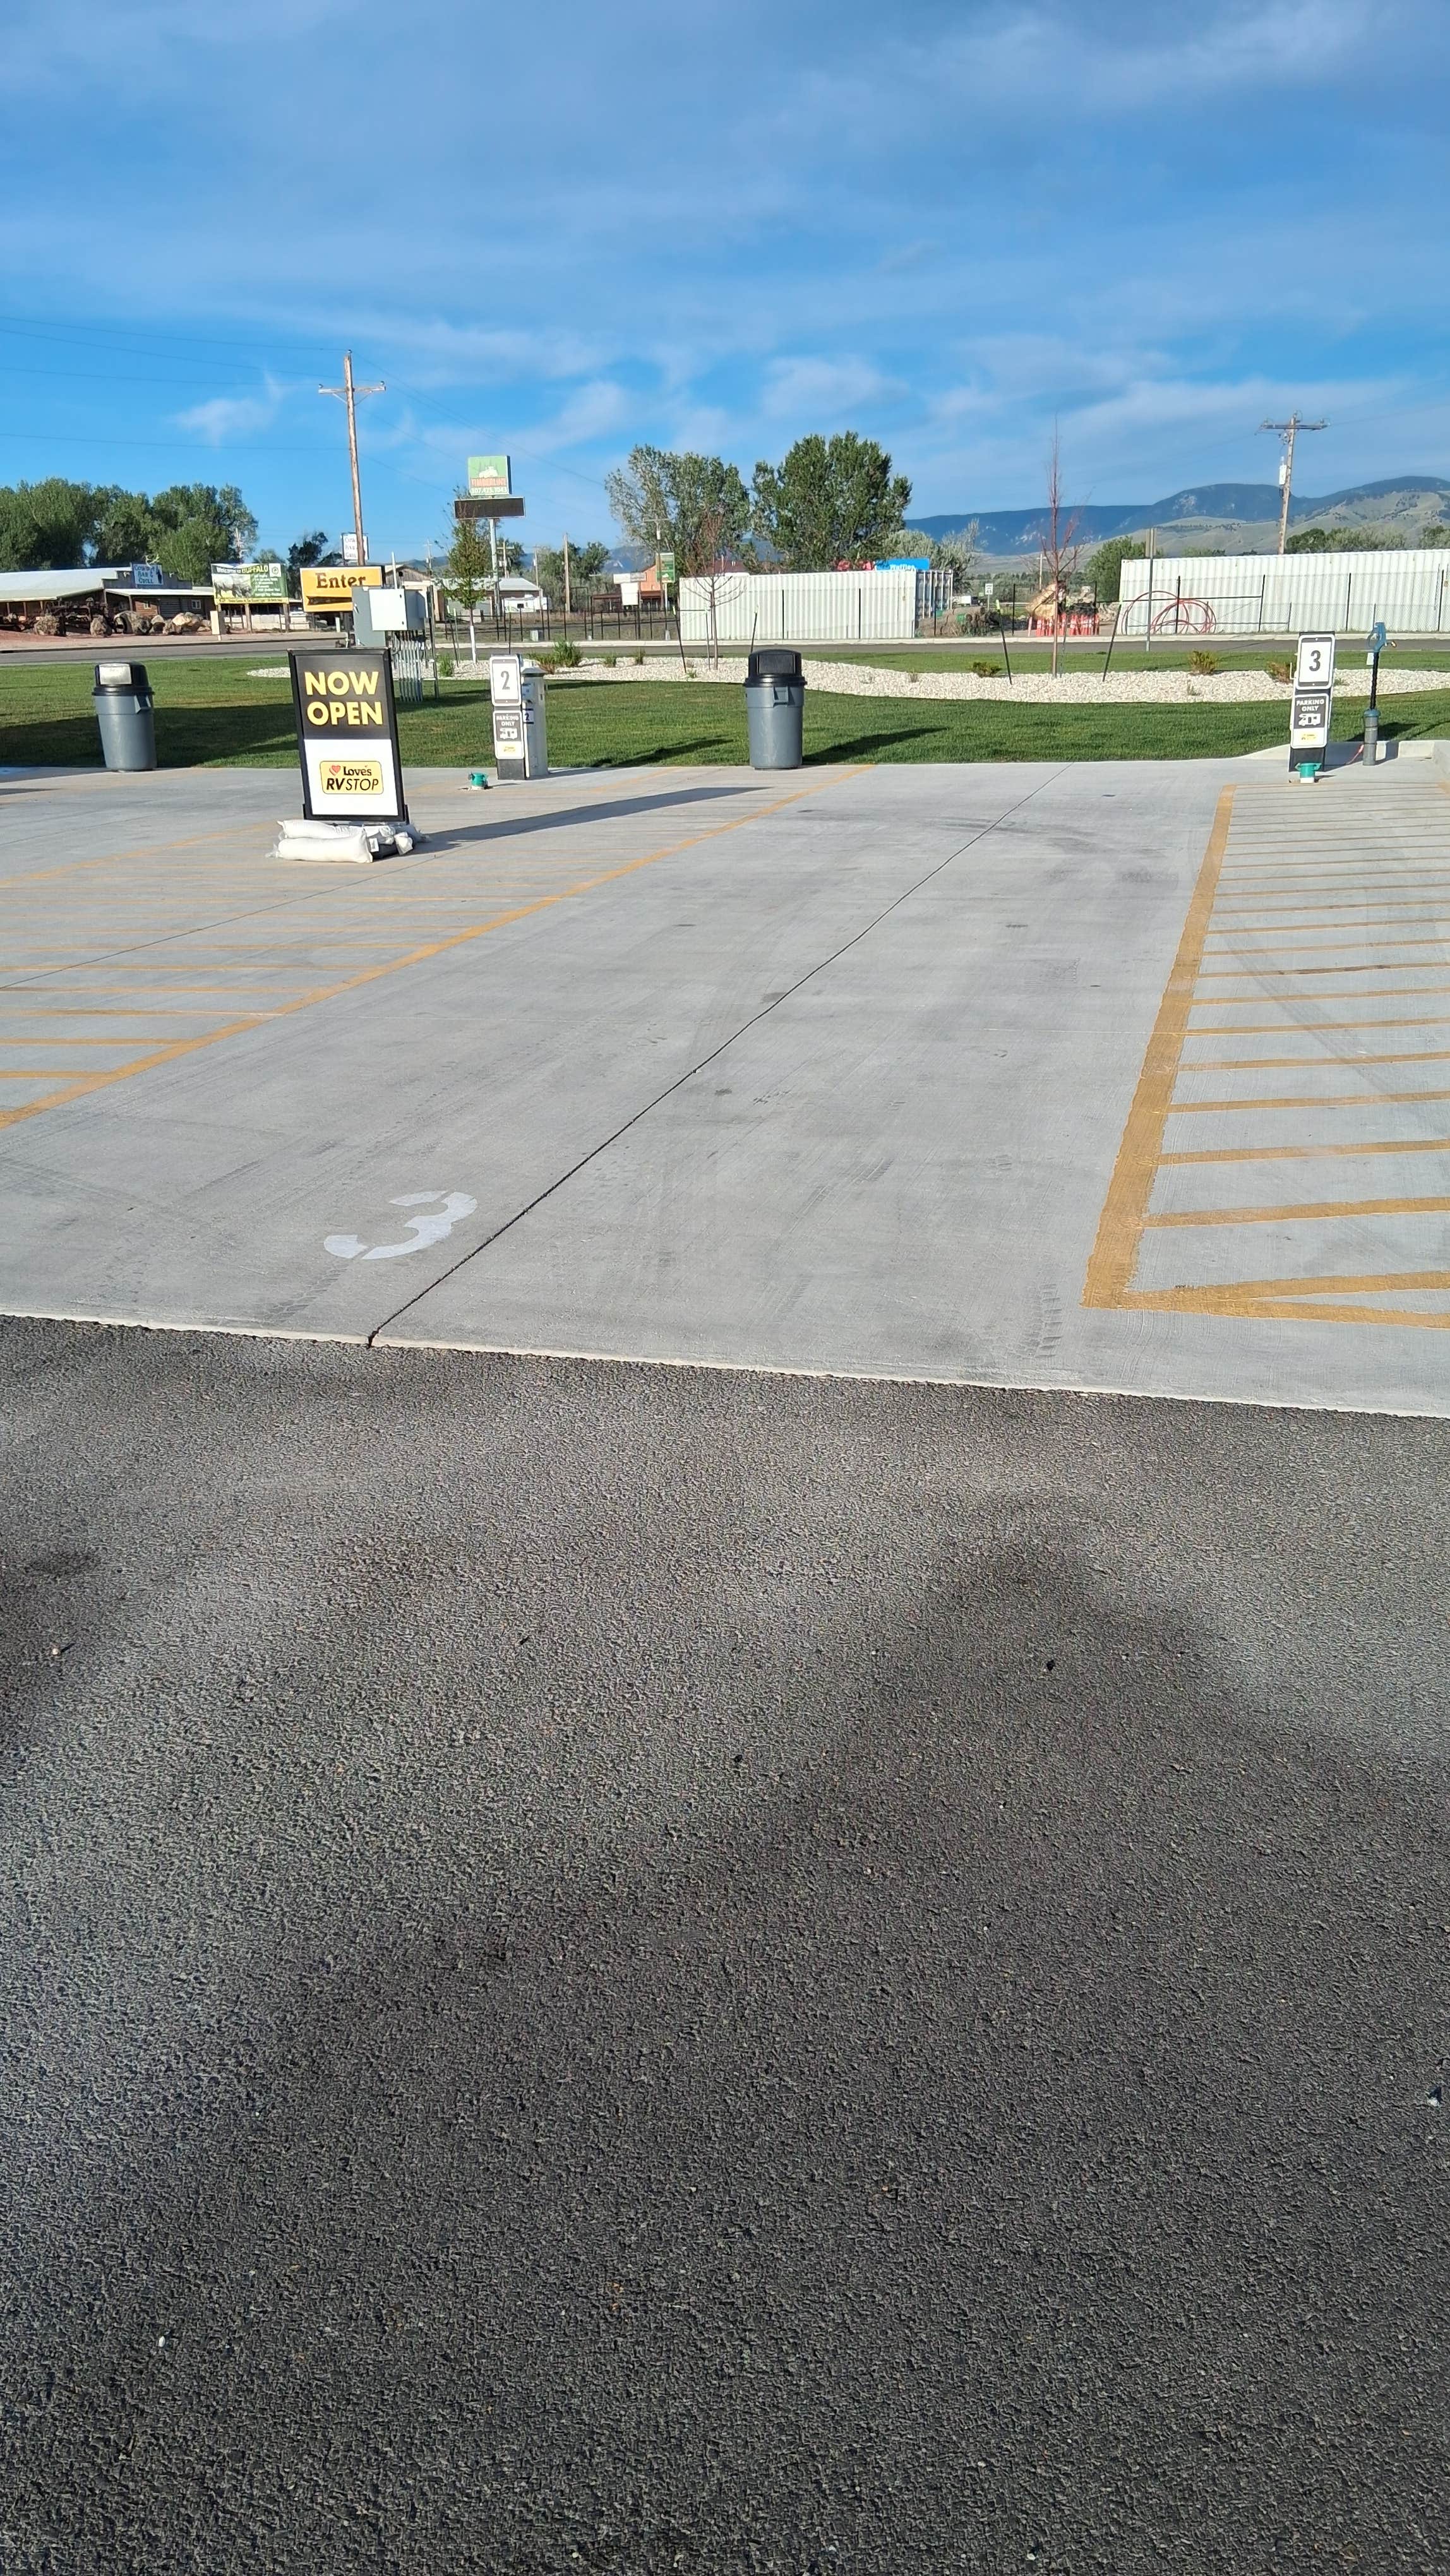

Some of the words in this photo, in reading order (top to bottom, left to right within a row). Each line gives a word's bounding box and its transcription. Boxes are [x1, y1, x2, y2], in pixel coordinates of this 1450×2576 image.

[241, 564, 268, 573] BUFFALO
[315, 573, 366, 588] Enter
[1309, 650, 1321, 672] 3
[304, 671, 379, 696] NOW
[500, 671, 510, 690] 2
[1296, 698, 1325, 707] PARKING
[307, 701, 383, 725] OPEN
[524, 712, 530, 721] 2
[324, 1190, 478, 1260] 3
